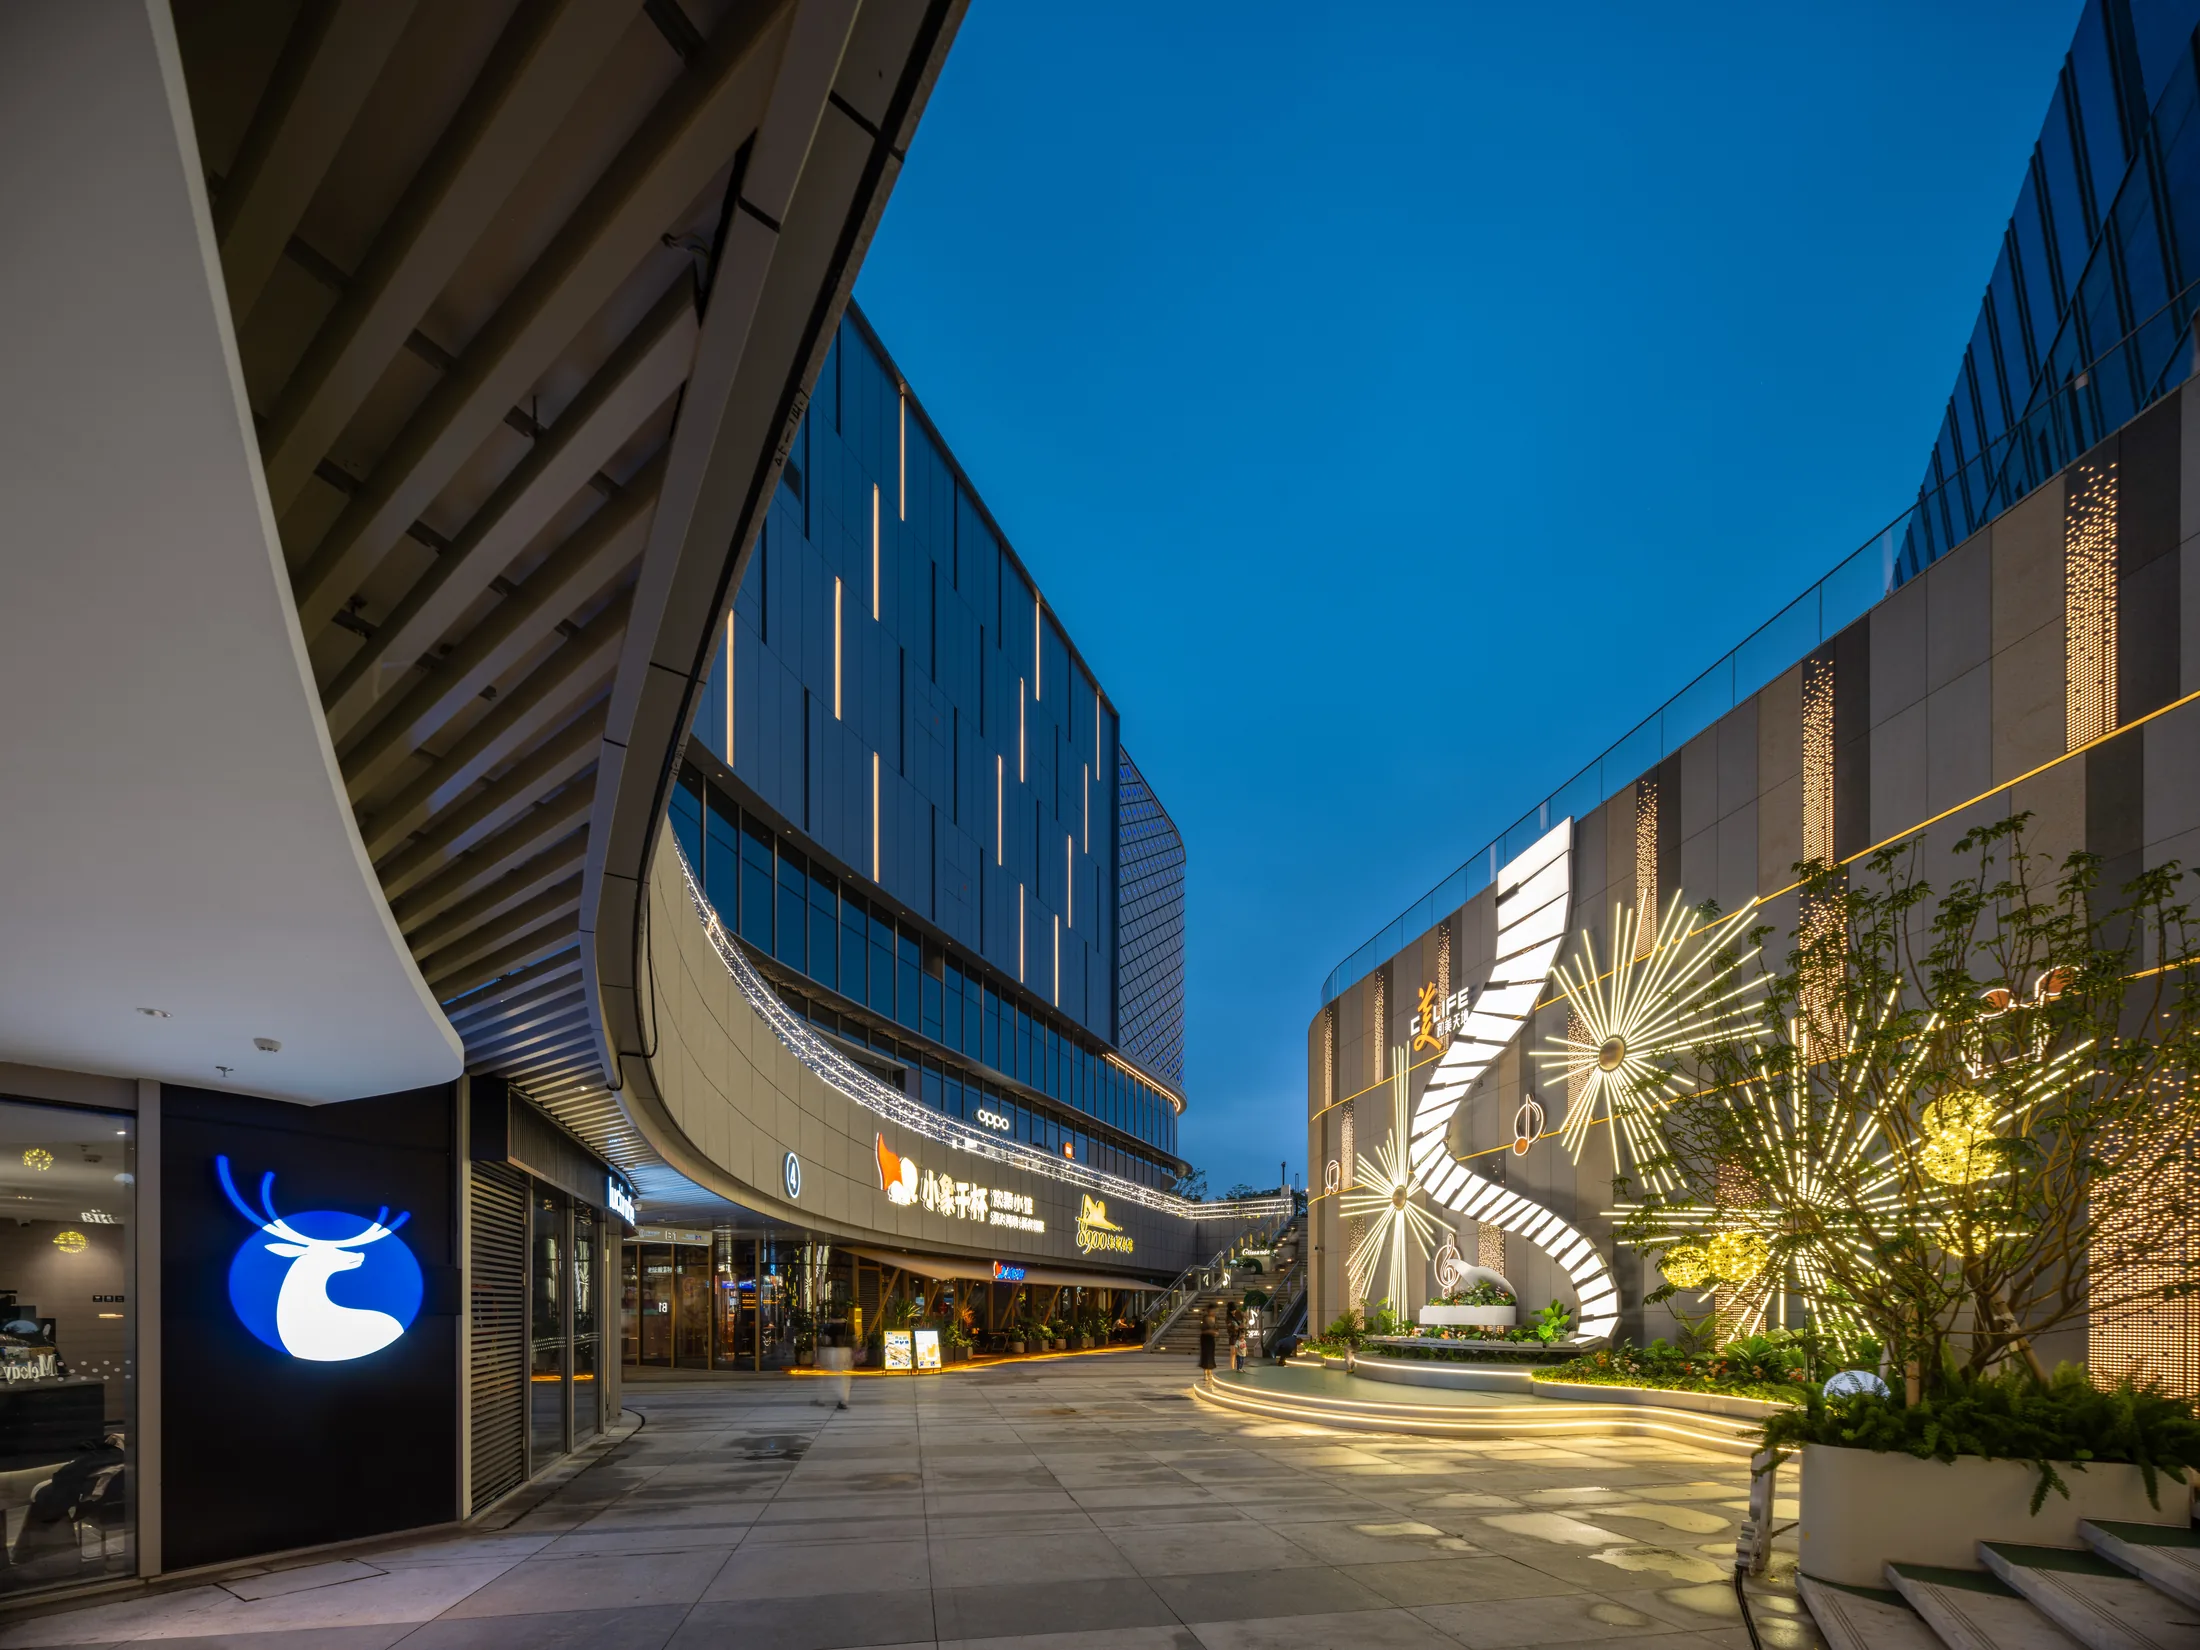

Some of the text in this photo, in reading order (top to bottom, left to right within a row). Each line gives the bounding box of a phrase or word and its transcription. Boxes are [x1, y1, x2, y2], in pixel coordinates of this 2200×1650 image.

[1437, 1008, 1469, 1038] 和美天地
[920, 1169, 989, 1222] 小象干杯
[664, 1230, 677, 1240] B1
